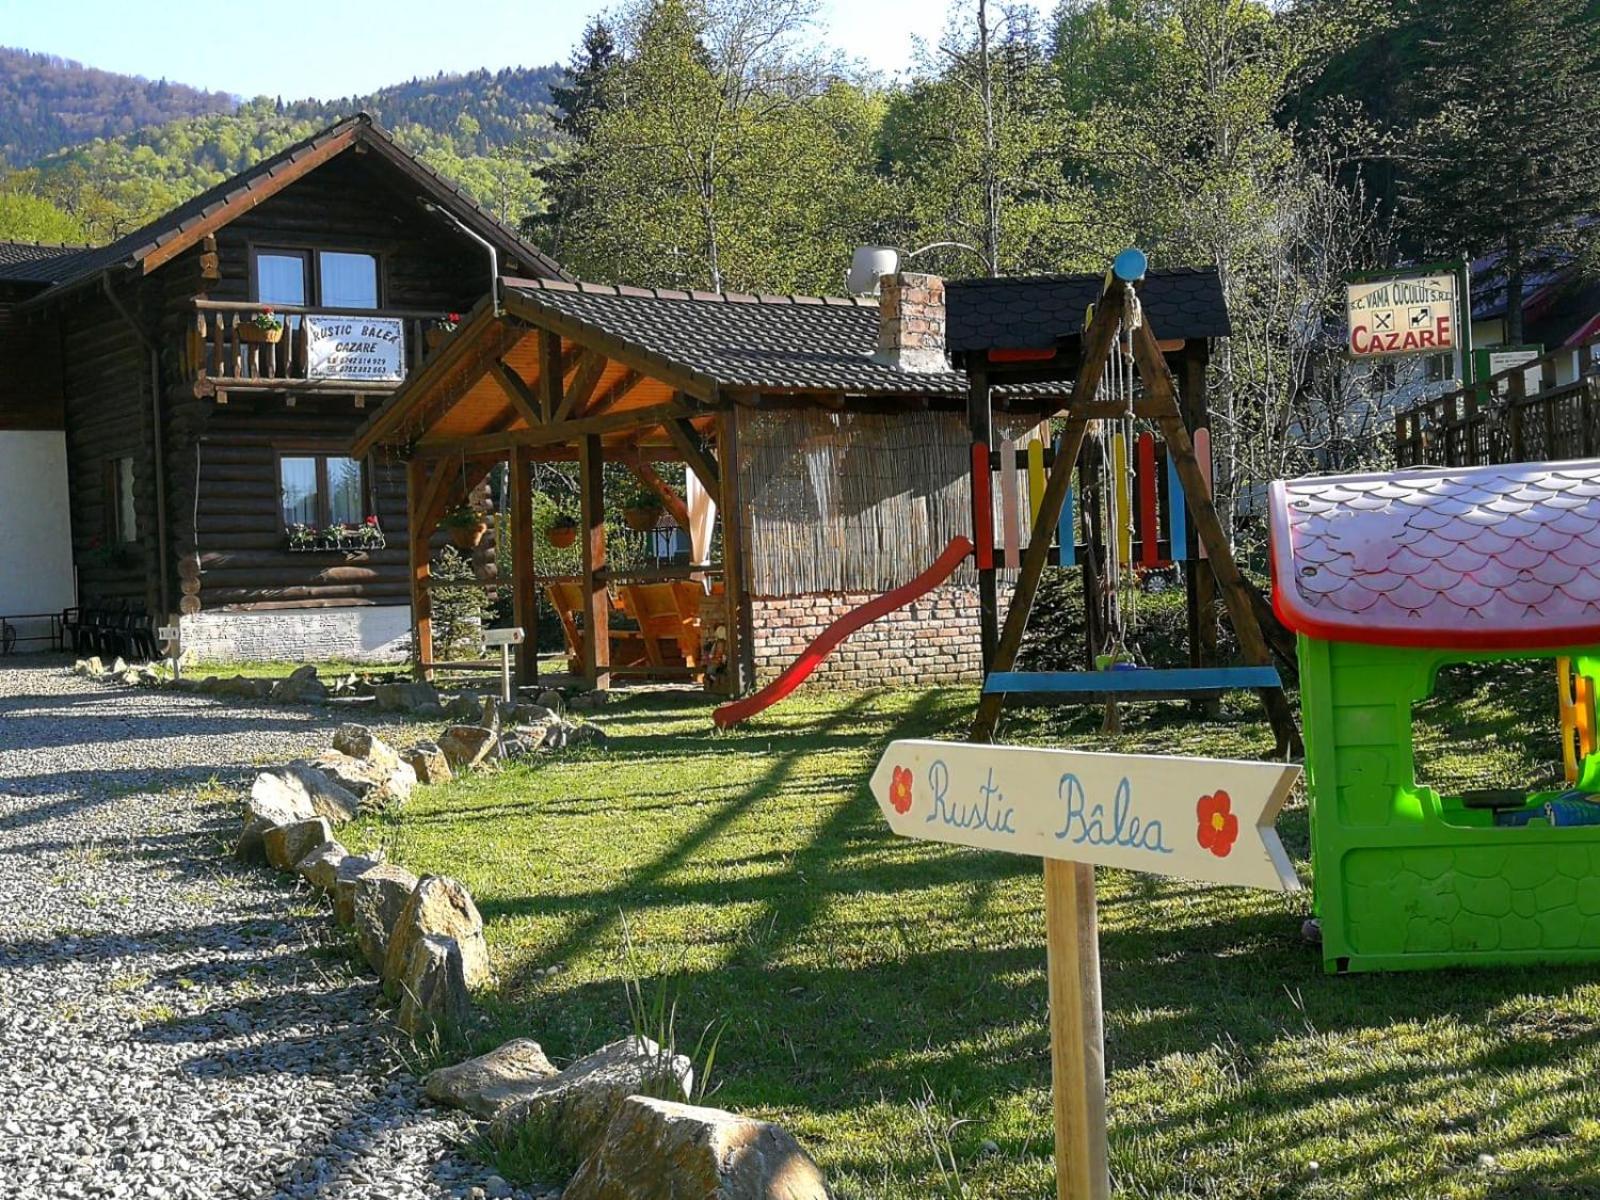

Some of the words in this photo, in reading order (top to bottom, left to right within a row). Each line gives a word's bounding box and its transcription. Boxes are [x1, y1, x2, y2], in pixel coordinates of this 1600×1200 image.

[1367, 286, 1390, 308] VAMA
[313, 324, 352, 342] RUSTIC
[1351, 316, 1451, 353] CAZARE
[335, 342, 377, 353] CAZARE
[926, 759, 1015, 834] Rustic
[1055, 772, 1174, 854] Bâlea
